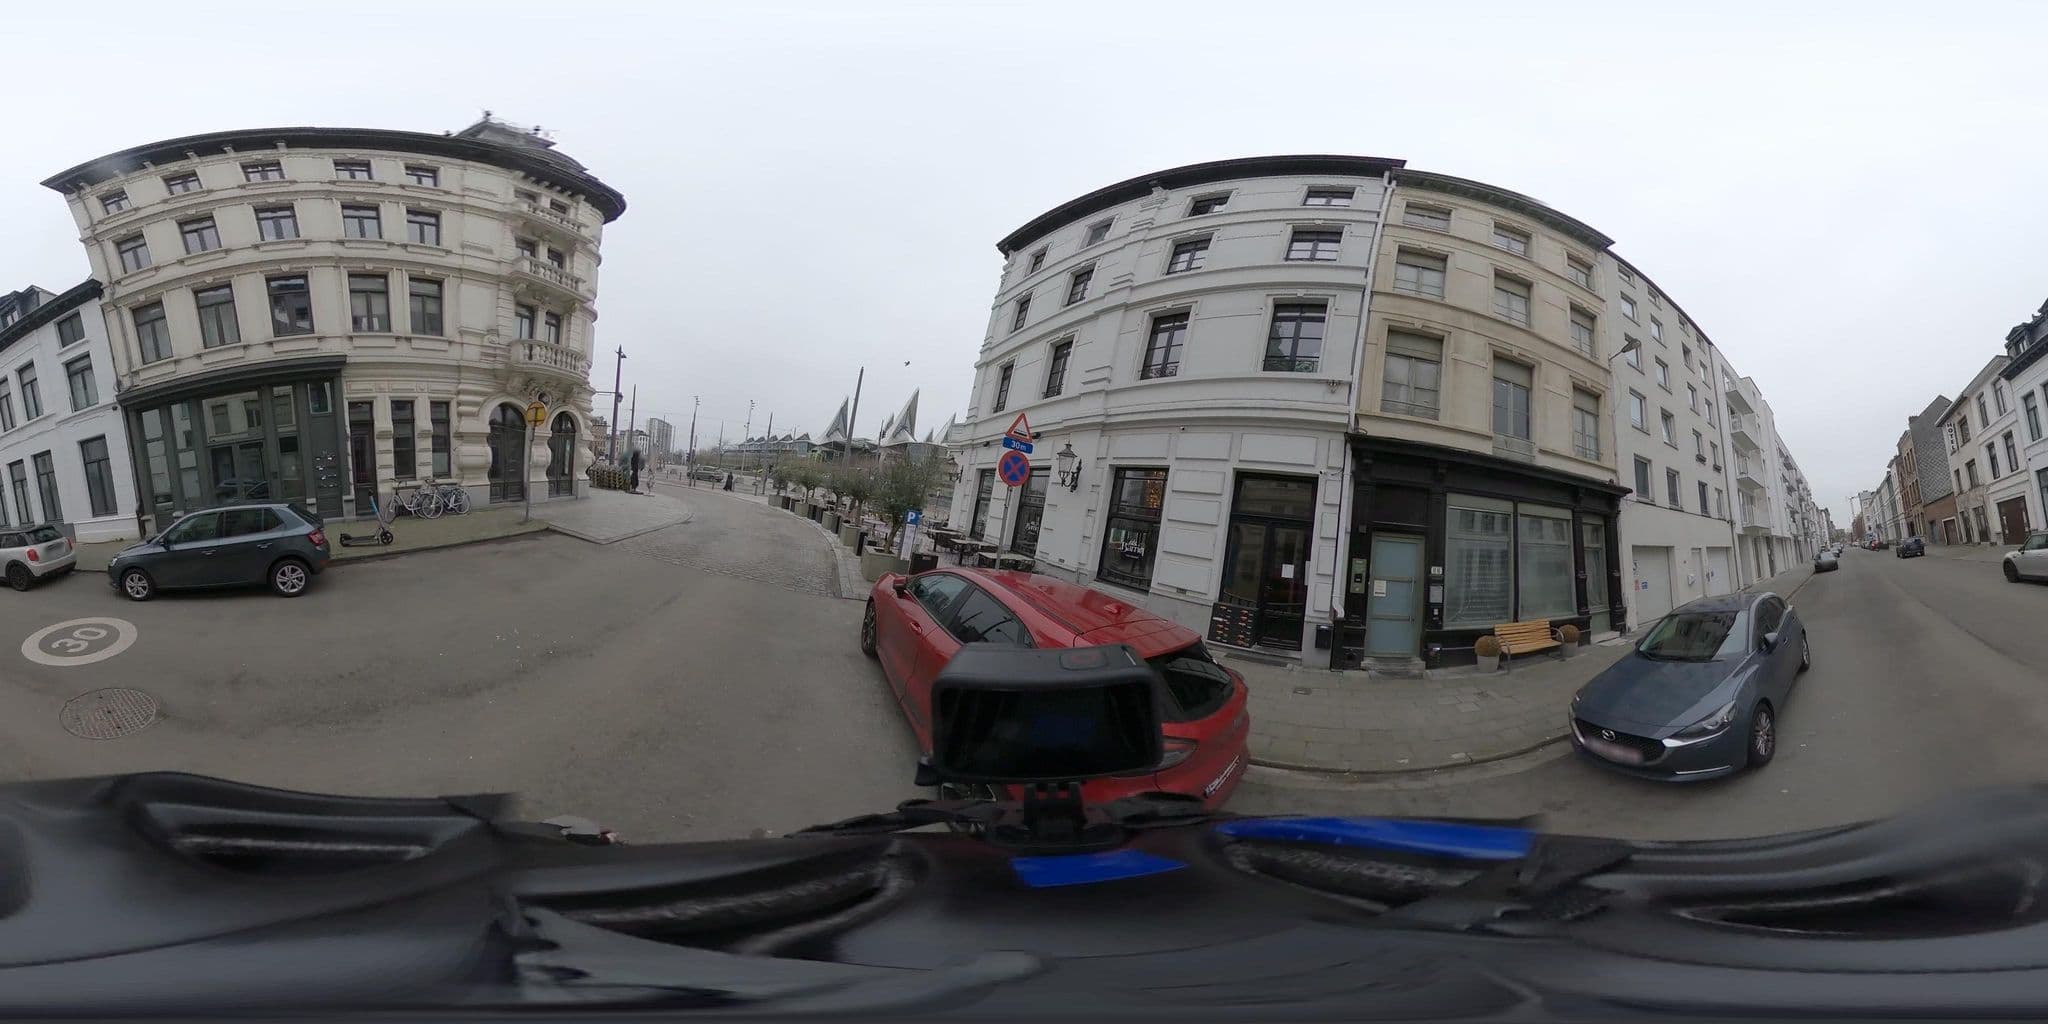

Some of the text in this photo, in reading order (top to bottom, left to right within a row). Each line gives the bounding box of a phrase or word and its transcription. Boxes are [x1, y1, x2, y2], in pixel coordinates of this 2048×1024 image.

[1946, 422, 1957, 450] HOTEL
[907, 511, 916, 523] P
[51, 627, 107, 653] 30
